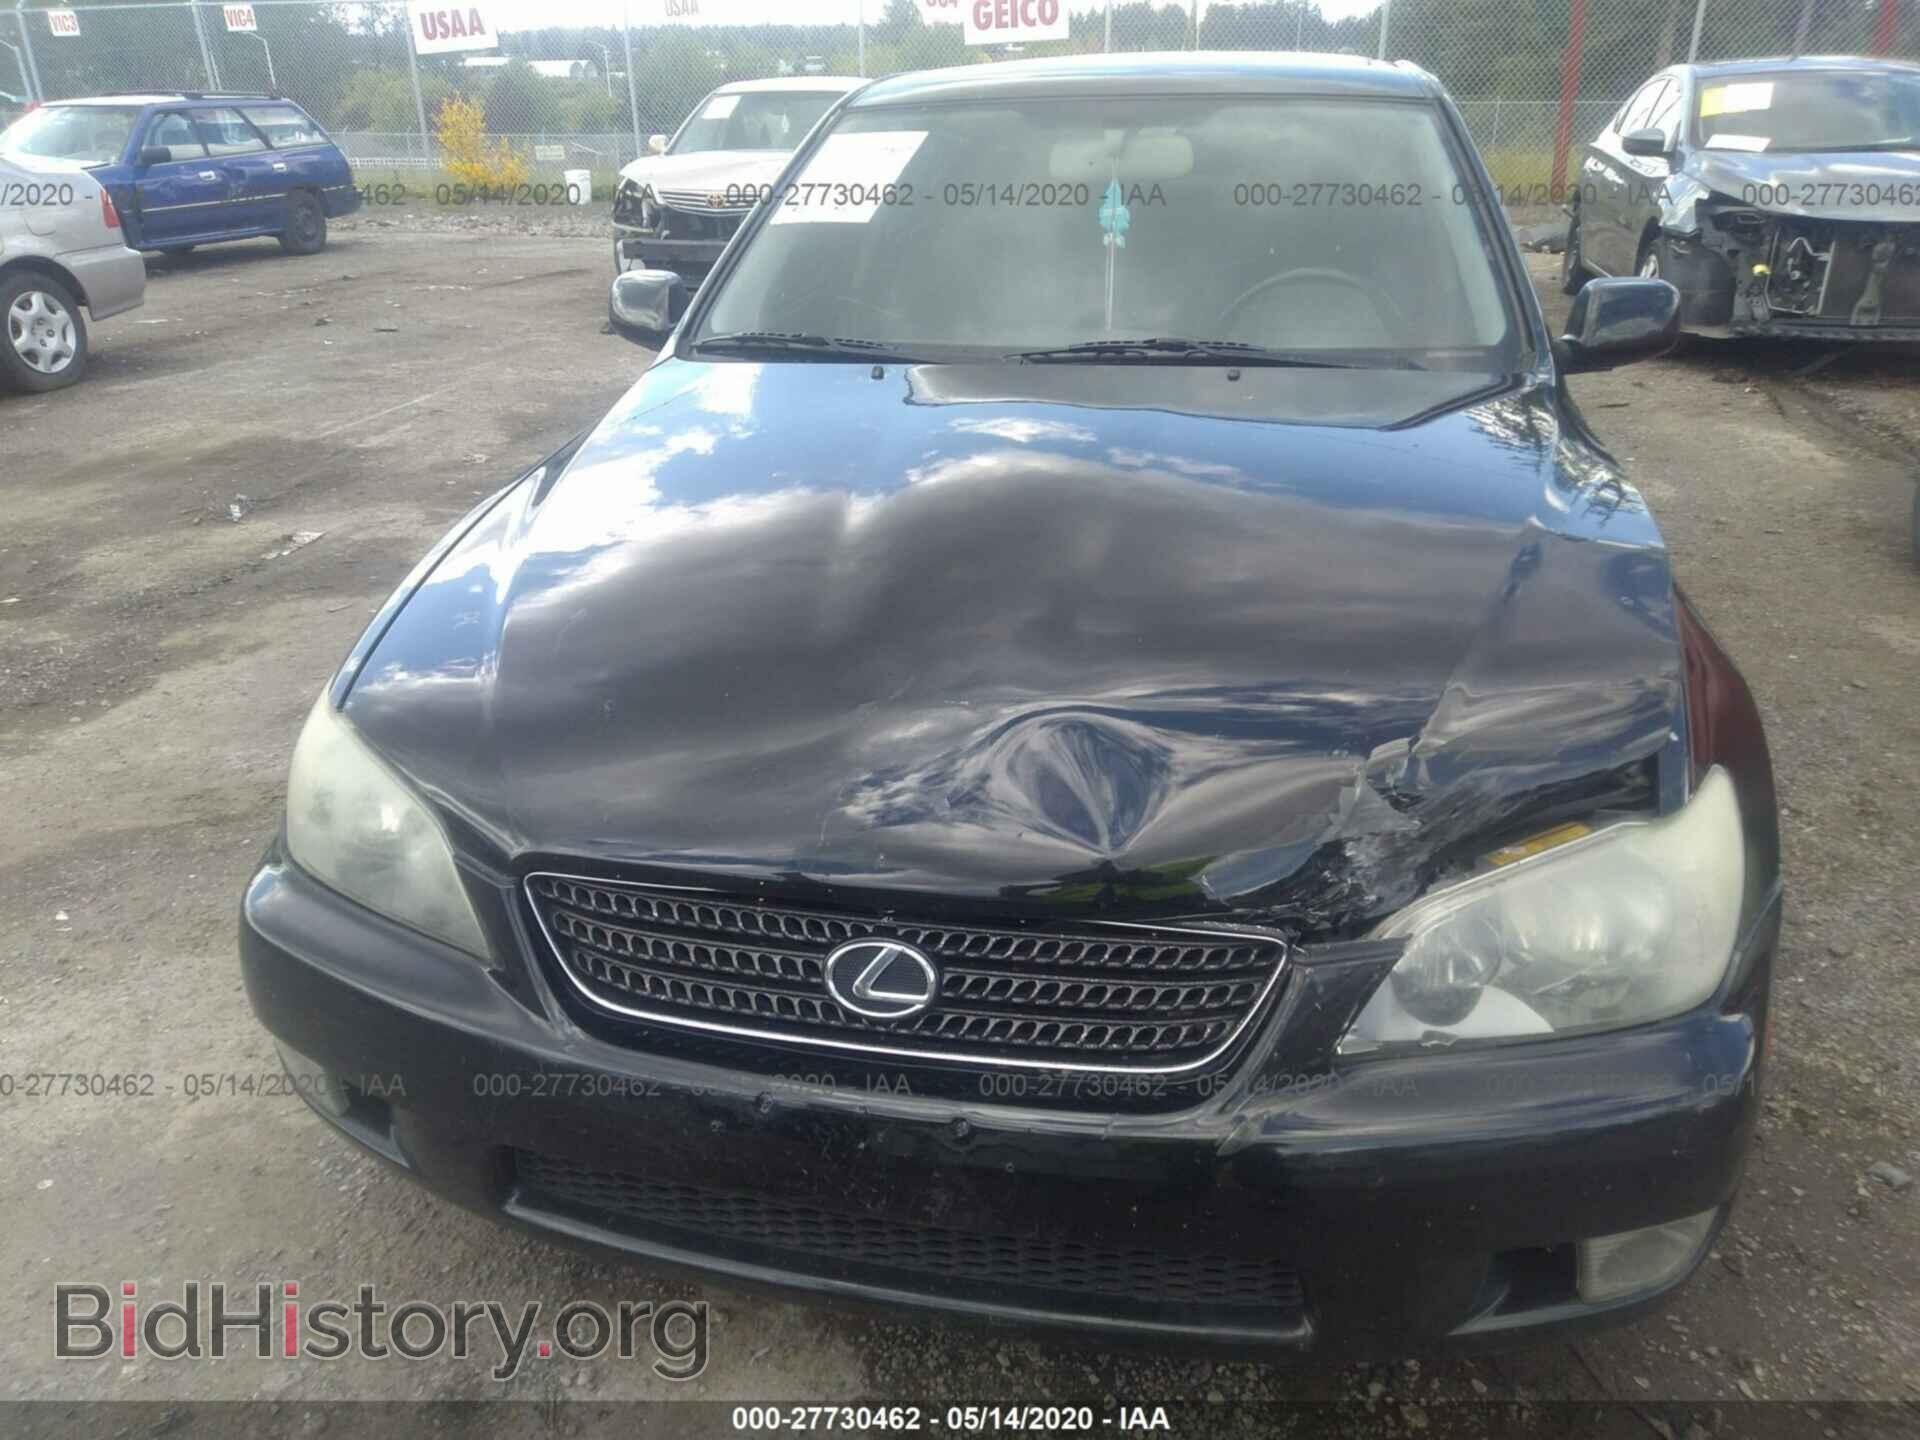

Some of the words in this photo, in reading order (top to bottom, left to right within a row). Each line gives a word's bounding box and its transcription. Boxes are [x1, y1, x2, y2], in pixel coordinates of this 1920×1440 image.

[49, 15, 77, 33] VIC3
[225, 9, 255, 27] VIC4
[419, 8, 486, 41] USAA
[973, 0, 1060, 31] GEICO
